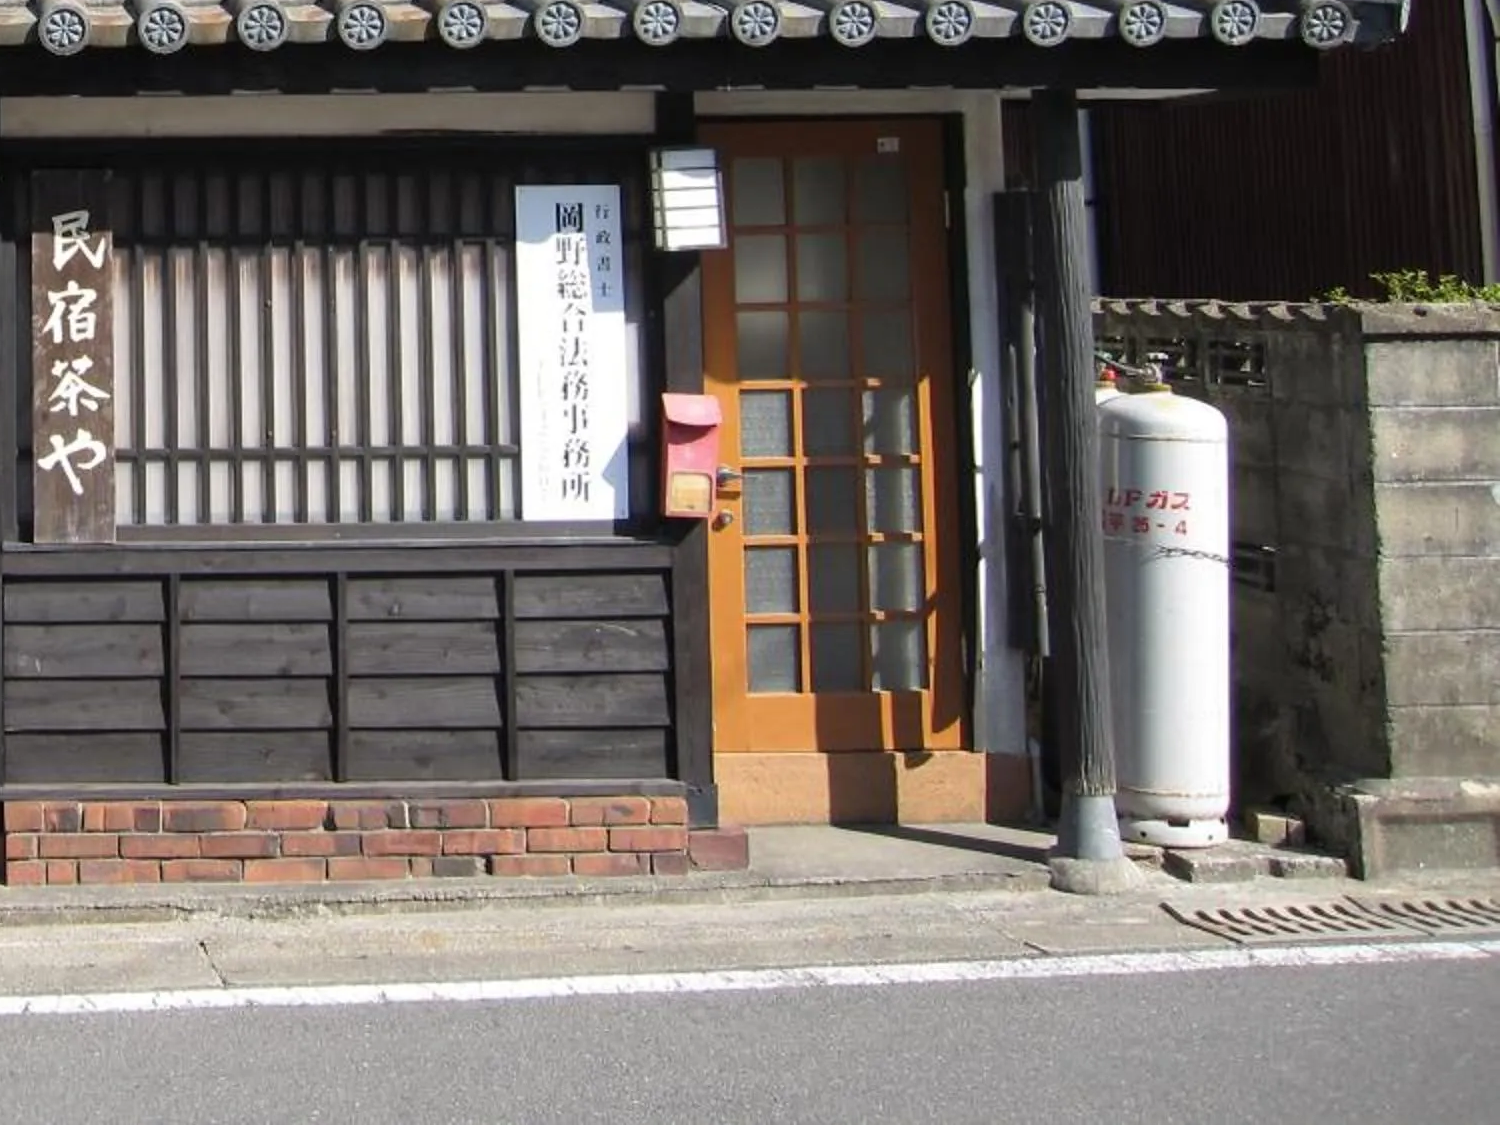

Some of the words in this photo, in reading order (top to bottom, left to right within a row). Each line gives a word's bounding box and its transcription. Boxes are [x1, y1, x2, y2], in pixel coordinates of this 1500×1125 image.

[595, 203, 611, 298] 行政書士
[37, 210, 110, 495] 民宿茶や
